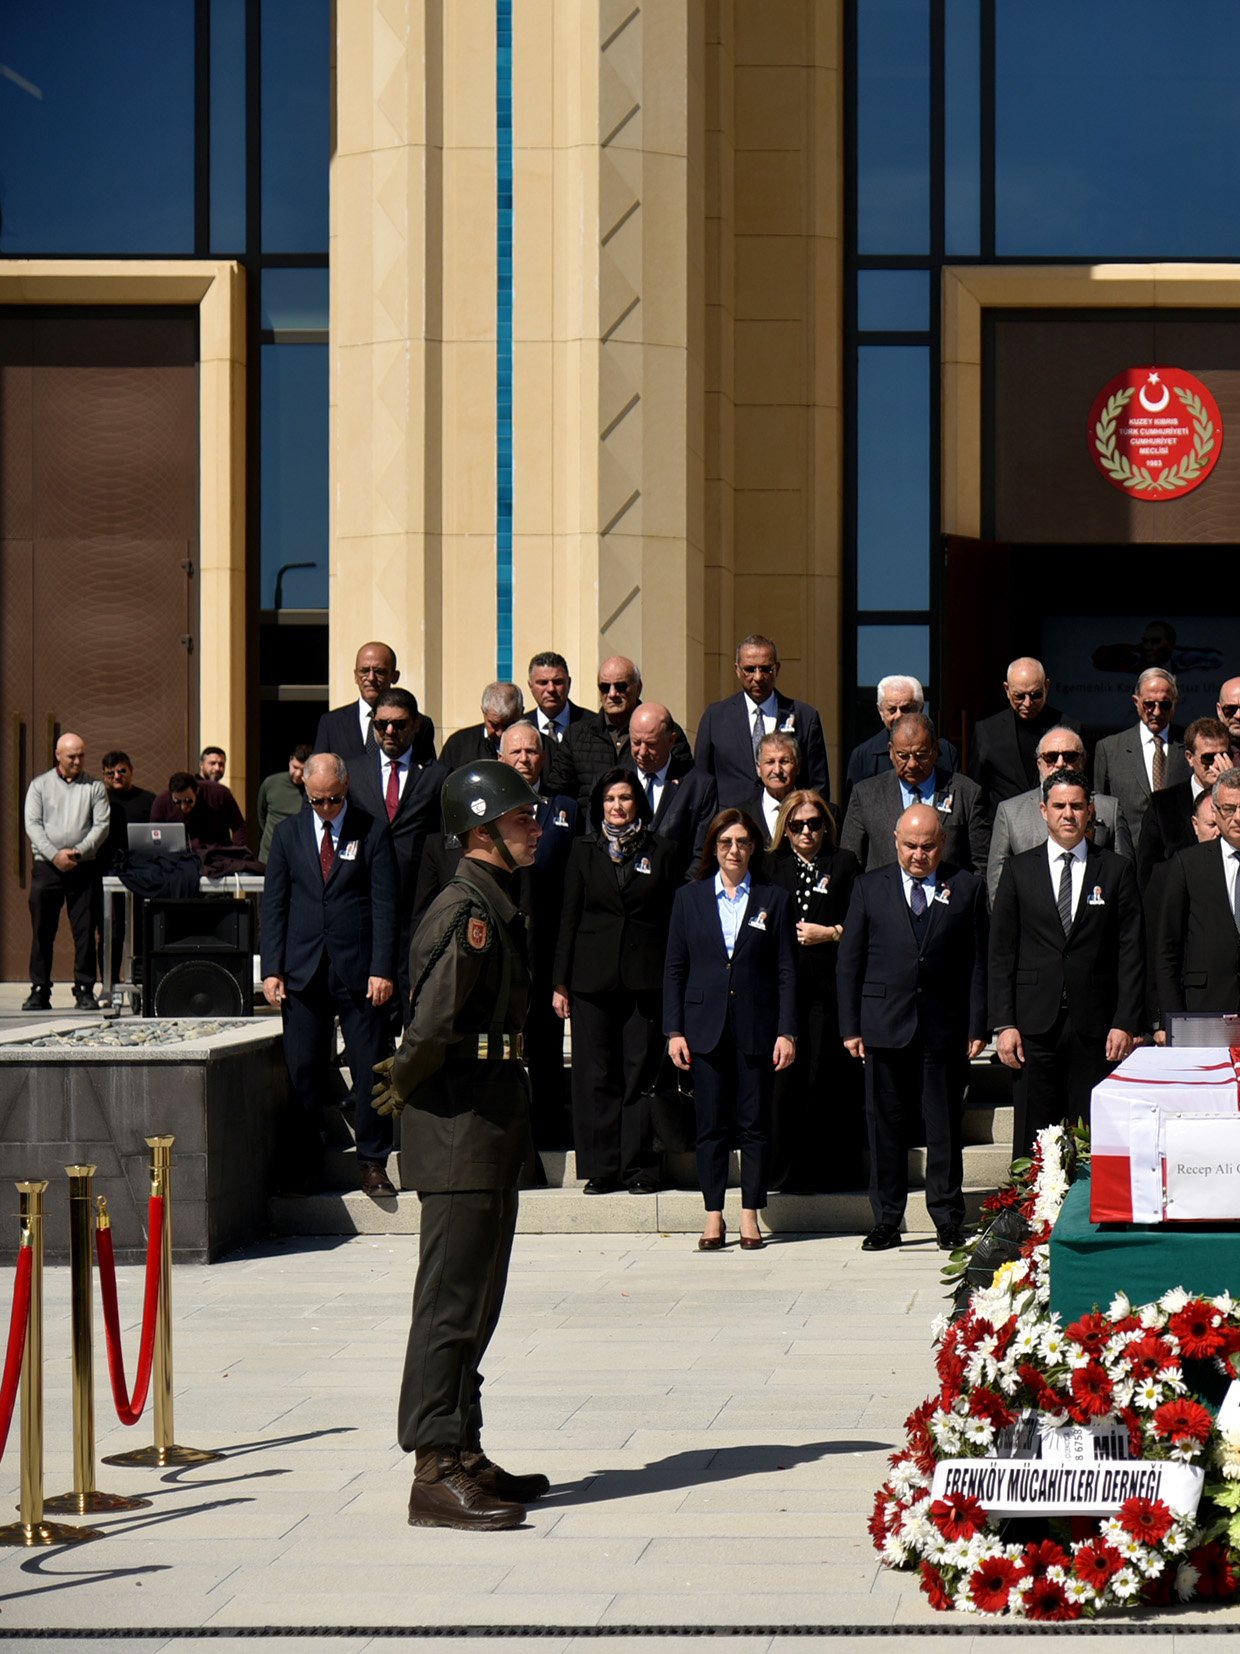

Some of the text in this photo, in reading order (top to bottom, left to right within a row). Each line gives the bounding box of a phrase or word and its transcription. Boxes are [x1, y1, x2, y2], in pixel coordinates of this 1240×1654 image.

[1140, 427, 1188, 435] CUMHURİYETİ
[1130, 437, 1177, 445] CUMHURİYET
[1177, 1163, 1212, 1177] Recep
[1216, 1163, 1233, 1175] Ali
[1007, 1463, 1100, 1502] MÜCAHİTLERİ
